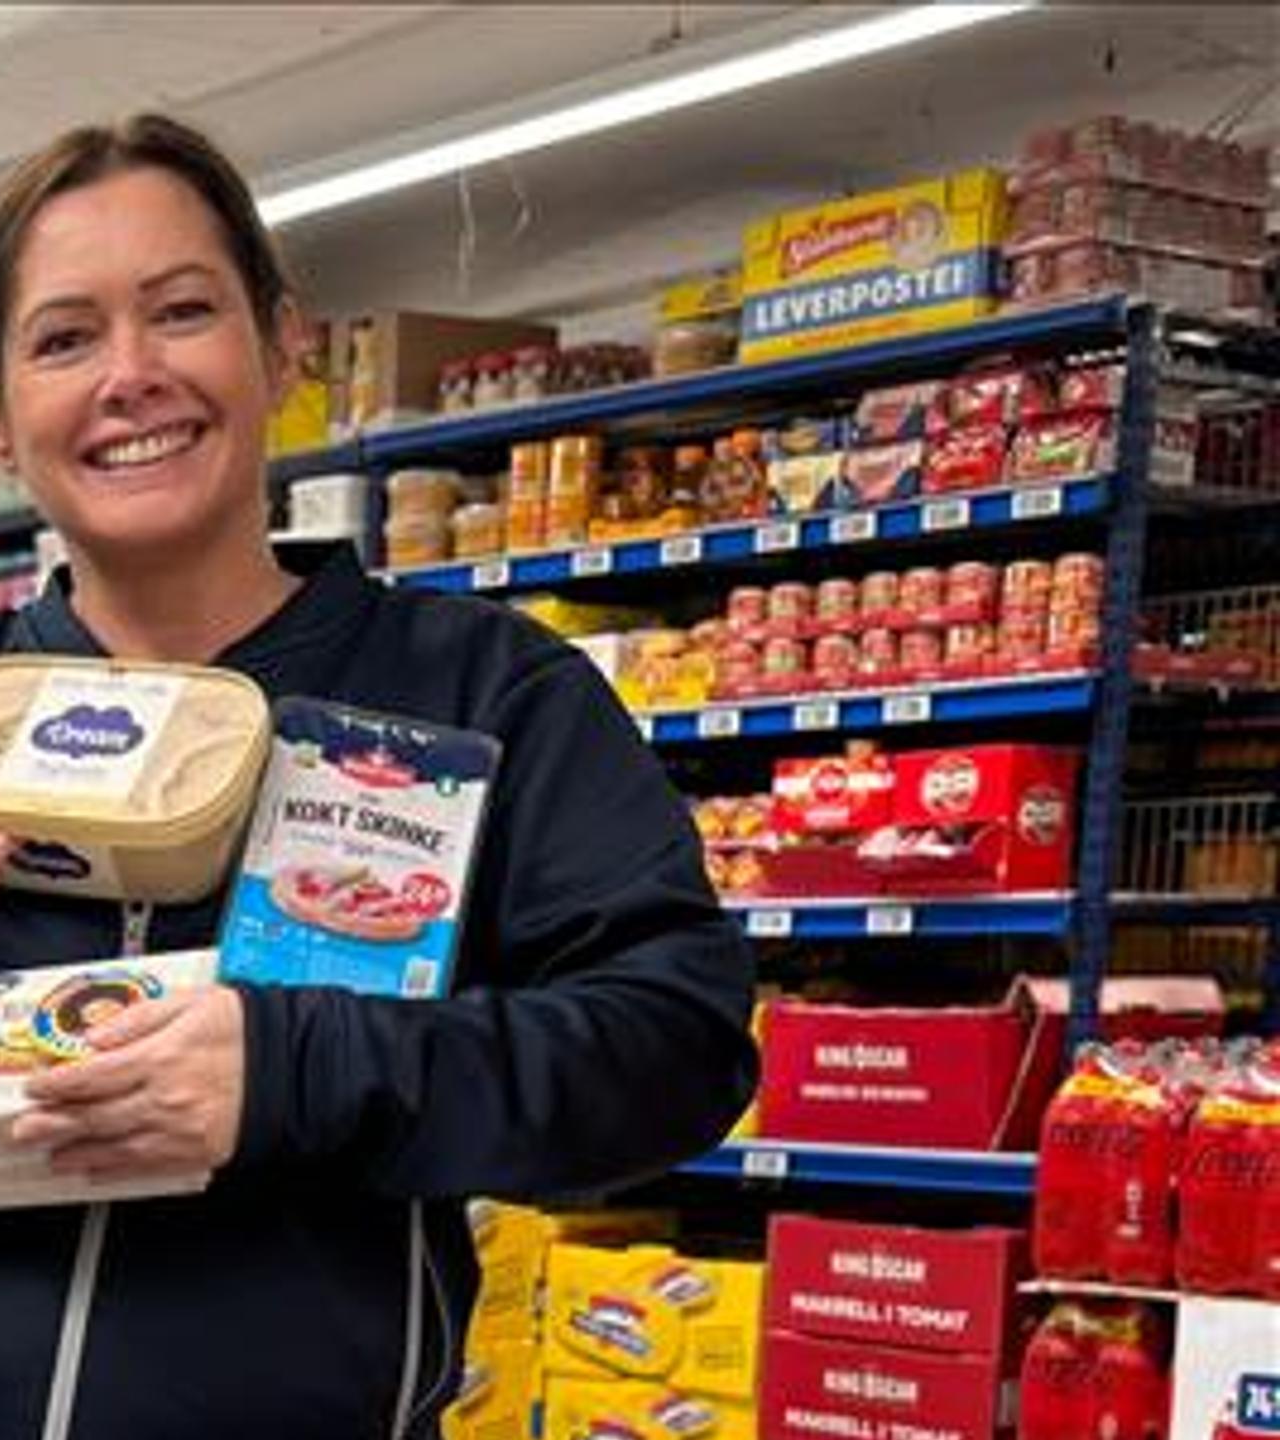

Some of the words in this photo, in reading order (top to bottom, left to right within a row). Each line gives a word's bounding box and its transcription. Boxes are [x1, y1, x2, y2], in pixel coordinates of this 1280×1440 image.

[755, 260, 965, 331] LEVERPOSTEI
[282, 797, 353, 829] KOKT
[354, 806, 448, 851] SKINKE
[896, 1305, 970, 1332] TOMAT
